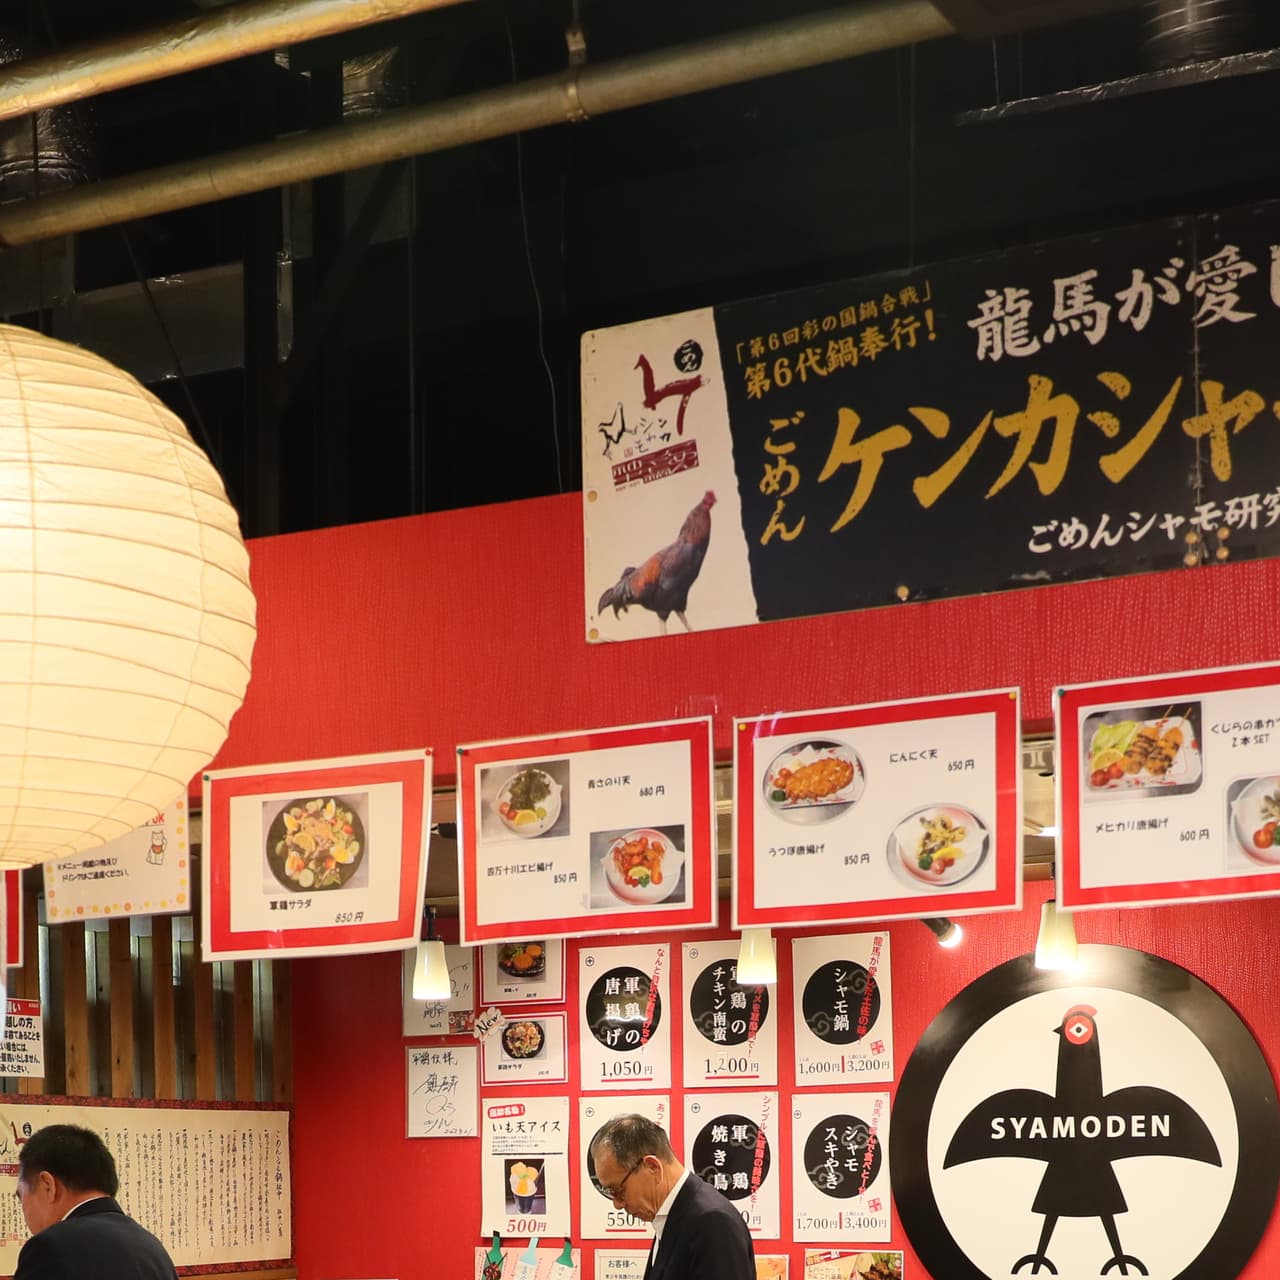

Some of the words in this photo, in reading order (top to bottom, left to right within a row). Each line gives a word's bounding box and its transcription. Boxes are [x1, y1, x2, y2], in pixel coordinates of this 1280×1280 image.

[736, 281, 933, 366] 「第6回彩の国鍋合戦」
[744, 310, 938, 401] 第6代鍋奉行!
[759, 410, 806, 546] ごめん
[888, 748, 939, 764] にんにく天
[947, 758, 976, 772] 650円
[639, 785, 665, 797] 680円
[1095, 817, 1170, 834] メヒカリ唐揚げ
[1179, 827, 1210, 842] 600円
[553, 871, 578, 884] 850円
[335, 911, 364, 923] 850円
[713, 967, 727, 1042] チキン南蛮
[833, 968, 849, 1032] シャモ鍋
[605, 977, 620, 1046] 唐揚げ
[624, 976, 640, 1045] 軍鶏の
[476, 1014, 498, 1034] New
[600, 1061, 653, 1077] 1,050円
[705, 1058, 759, 1074] 1,200円
[799, 1062, 840, 1074] 1,600円
[847, 1060, 890, 1072] 3,200円
[492, 1121, 561, 1133] いも天アイス
[991, 1115, 1172, 1139] SYAMODEN
[732, 1124, 748, 1190] 軍鶏
[844, 1126, 859, 1172] シャモ
[712, 1125, 728, 1190] 焼き鳥
[825, 1128, 839, 1190] スキやき
[507, 1219, 546, 1233] 500円
[796, 1217, 838, 1229] 1,700円
[844, 1216, 887, 1229] 3,400円
[608, 1259, 638, 1269] お客様へ
